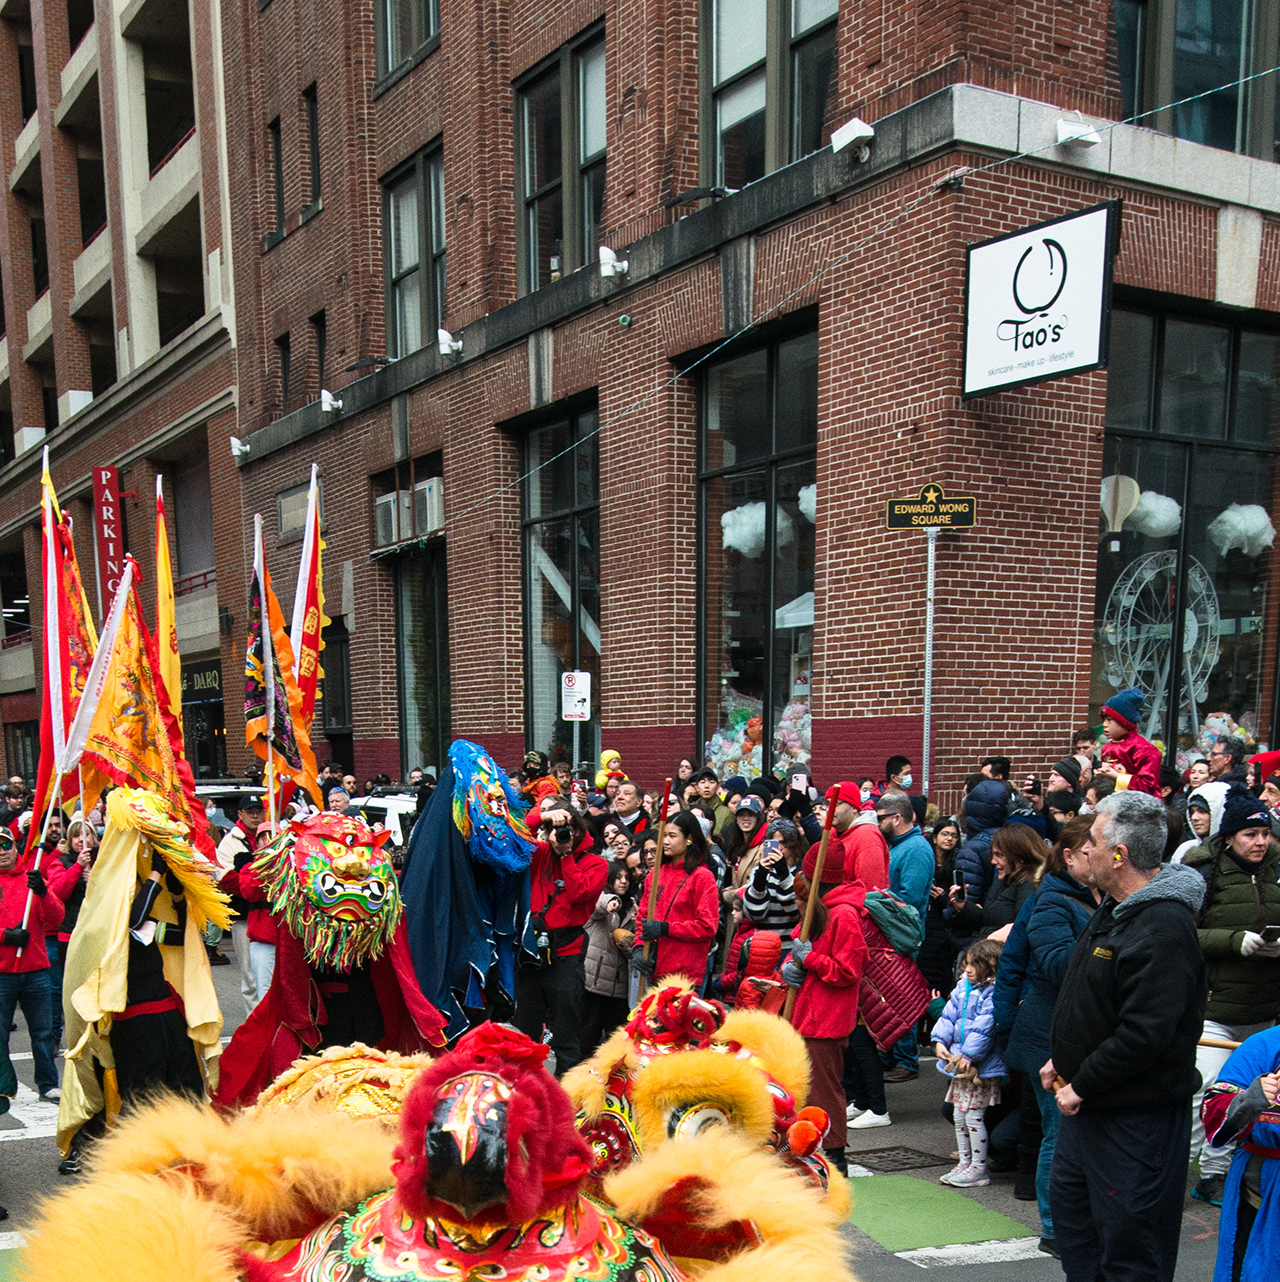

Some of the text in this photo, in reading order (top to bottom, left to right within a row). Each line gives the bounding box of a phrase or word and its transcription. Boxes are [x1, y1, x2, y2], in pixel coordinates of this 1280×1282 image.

[997, 314, 1068, 352] Tao's
[894, 503, 970, 514] EDWARD WONG
[911, 515, 952, 525] SQUARE
